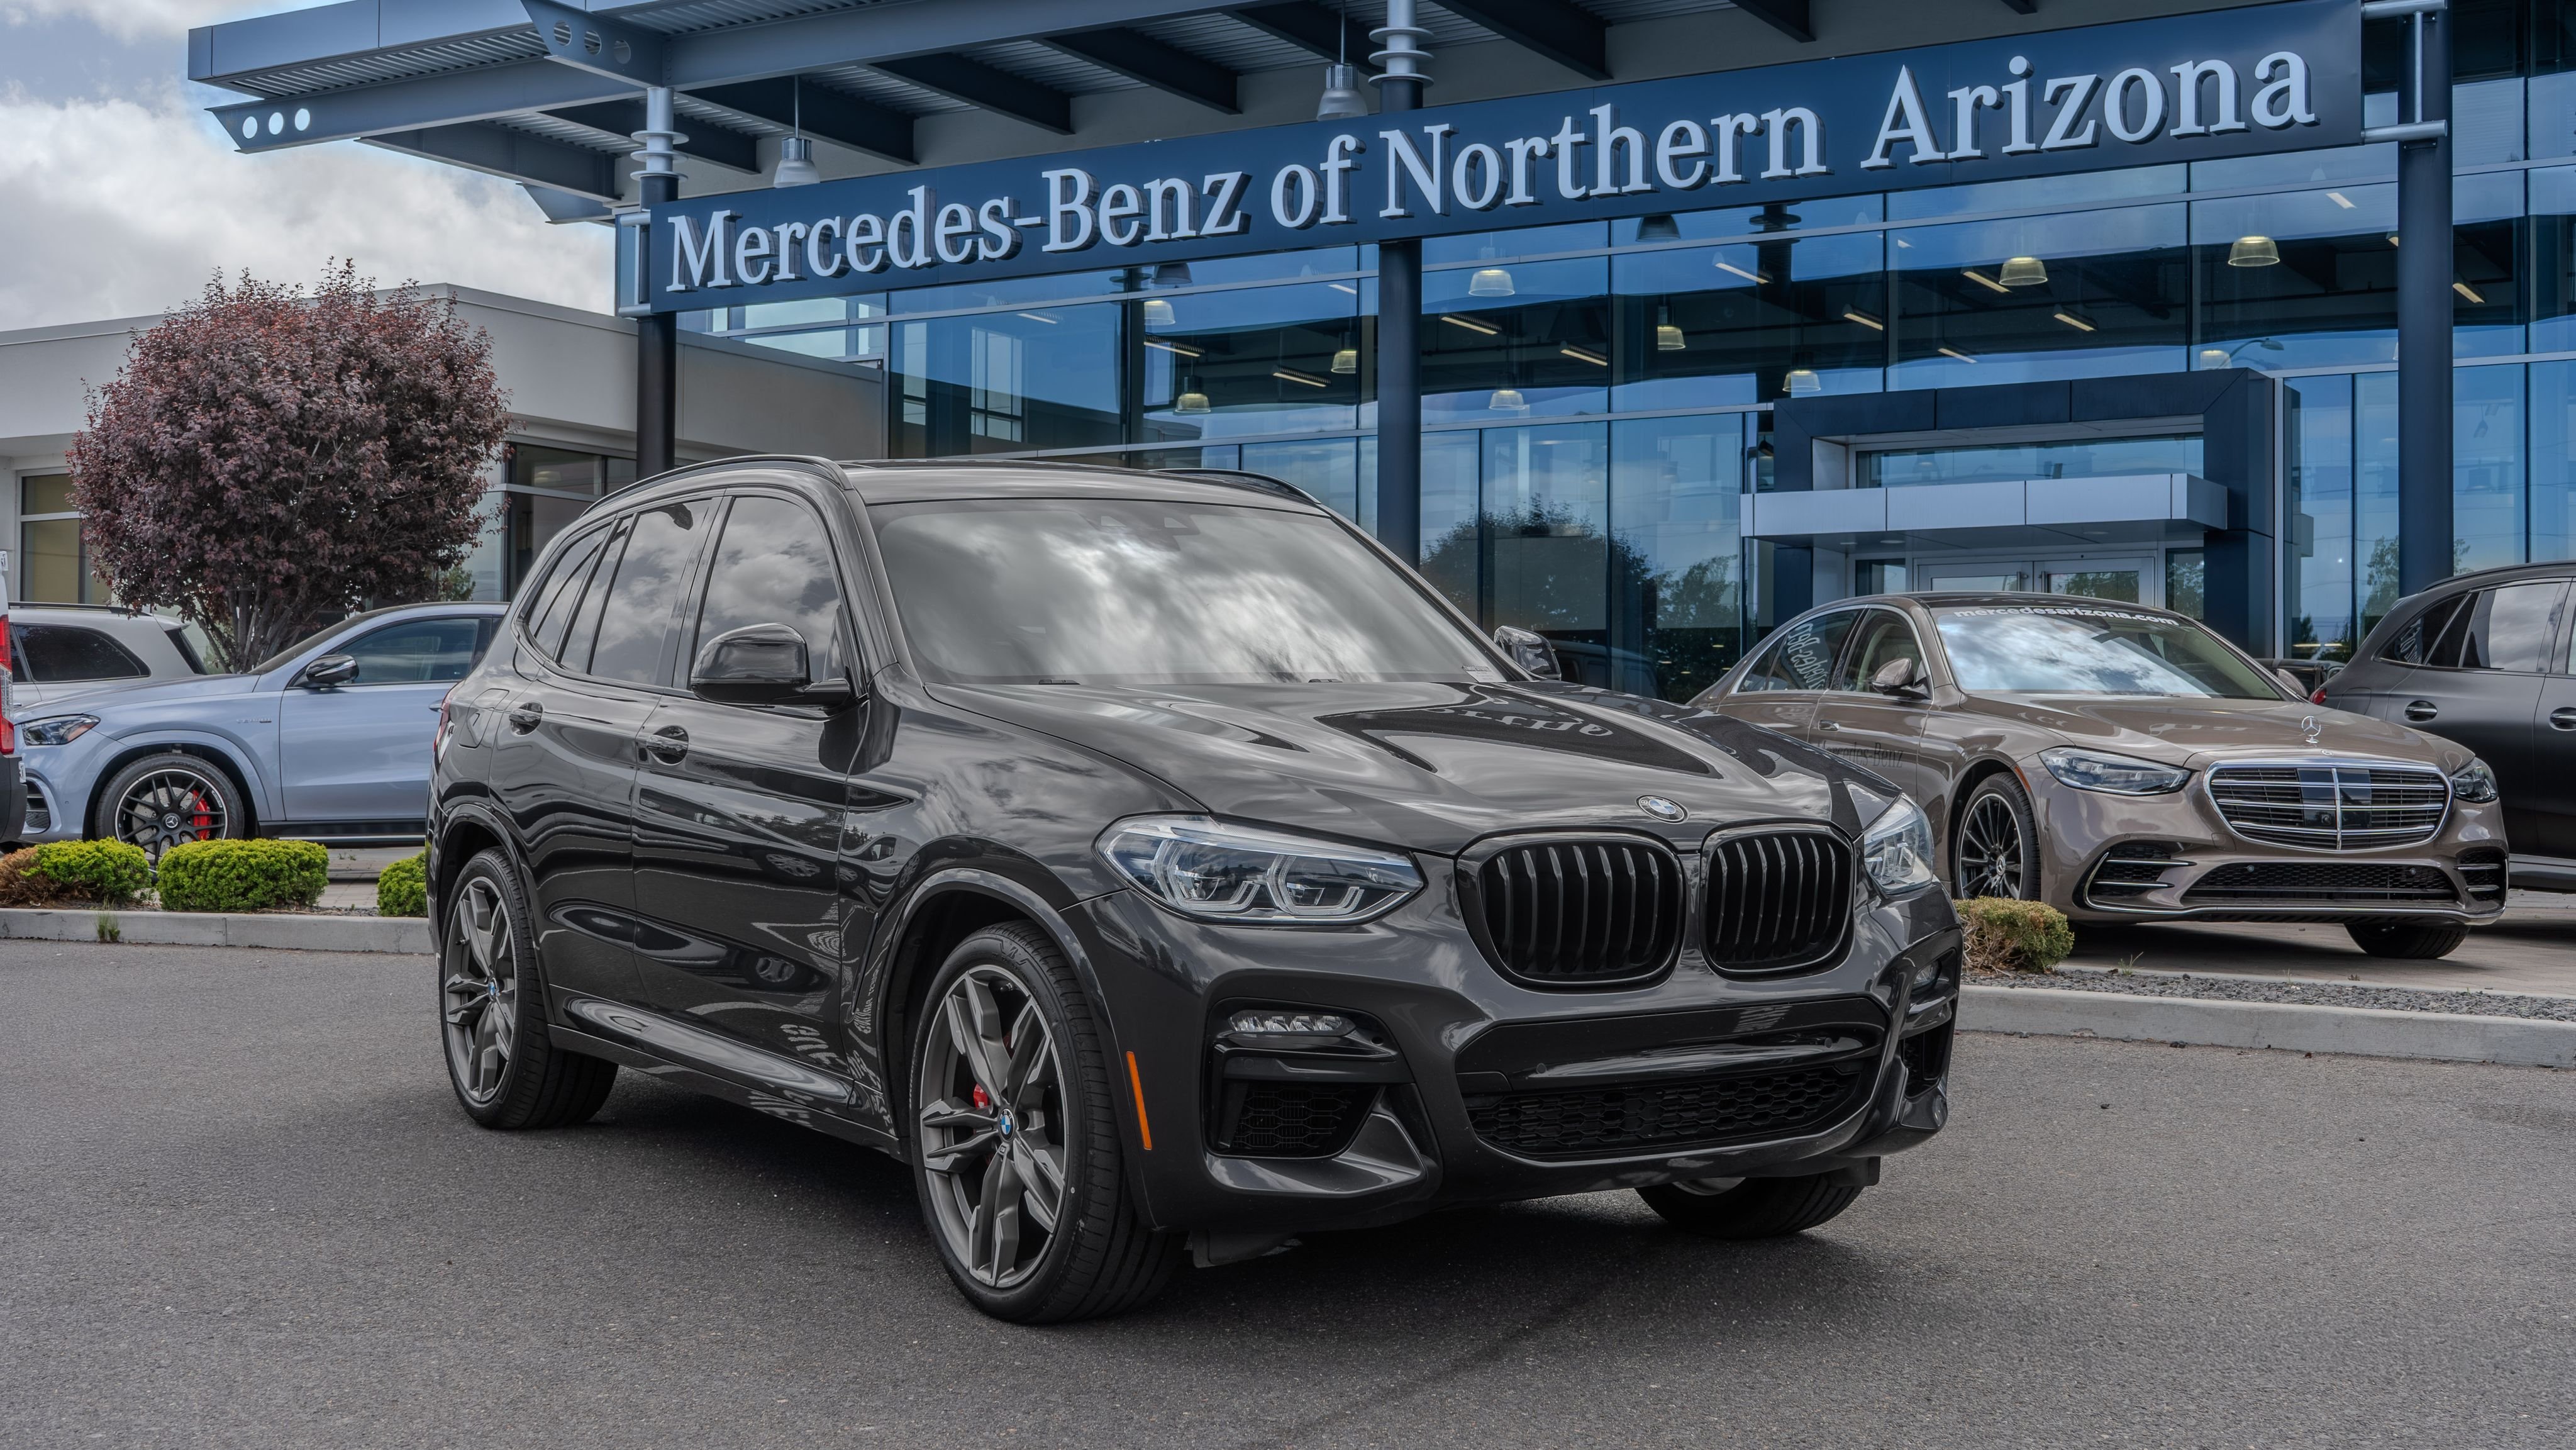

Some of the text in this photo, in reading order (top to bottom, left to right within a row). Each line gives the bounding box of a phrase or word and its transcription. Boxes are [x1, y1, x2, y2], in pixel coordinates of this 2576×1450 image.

[666, 52, 2319, 293] Mercedes-Benz of Northern Arizona
[1953, 606, 2180, 627] mercedesarizona.com
[1817, 740, 1904, 768] cedes-Benz
